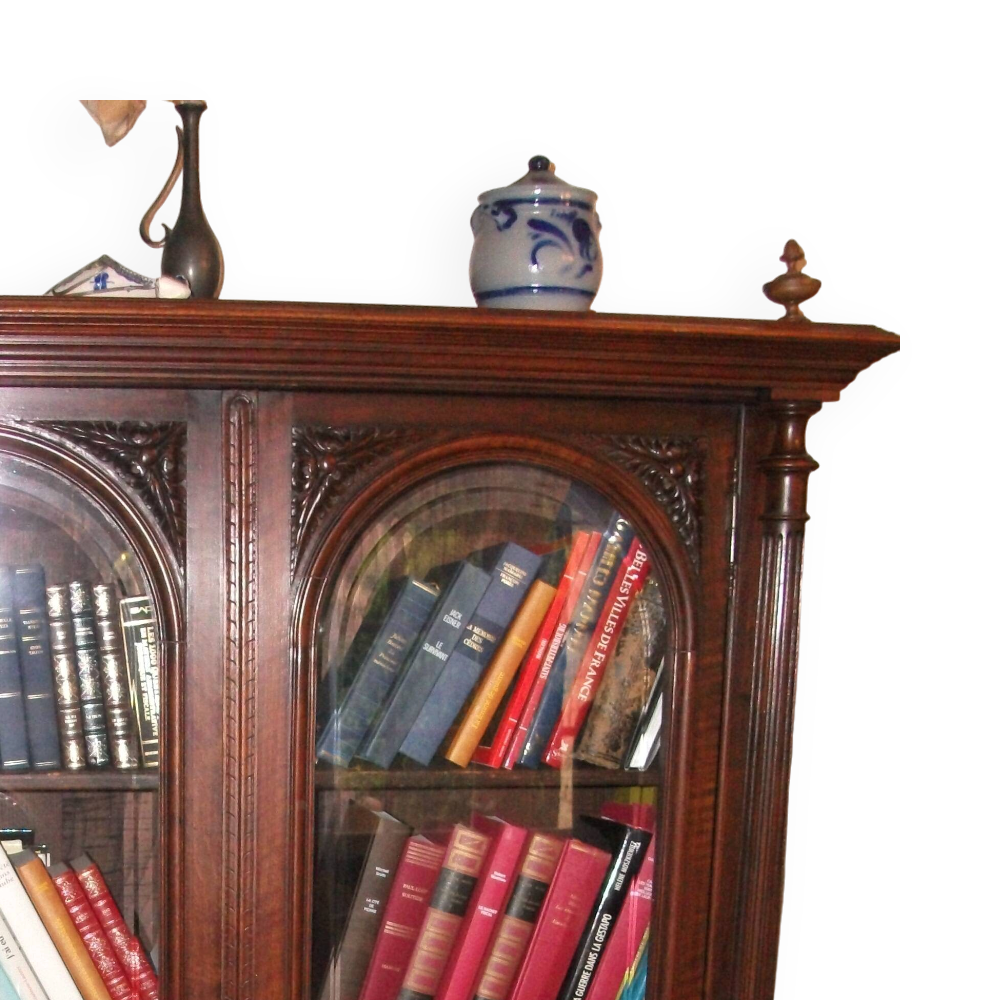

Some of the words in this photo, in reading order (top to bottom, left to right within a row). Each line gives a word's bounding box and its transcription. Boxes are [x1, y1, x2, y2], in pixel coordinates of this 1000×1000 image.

[441, 614, 462, 629] EISNER
[448, 608, 463, 620] JACK
[602, 592, 628, 634] VILLES
[435, 640, 443, 649] LE
[596, 633, 611, 651] DE
[576, 651, 605, 702] FRANCE
[593, 912, 612, 942] GESTAPO
[2, 945, 15, 959] J'ai
[590, 941, 601, 951] LA
[584, 950, 598, 970] DANS
[574, 969, 591, 997] GUERRE
